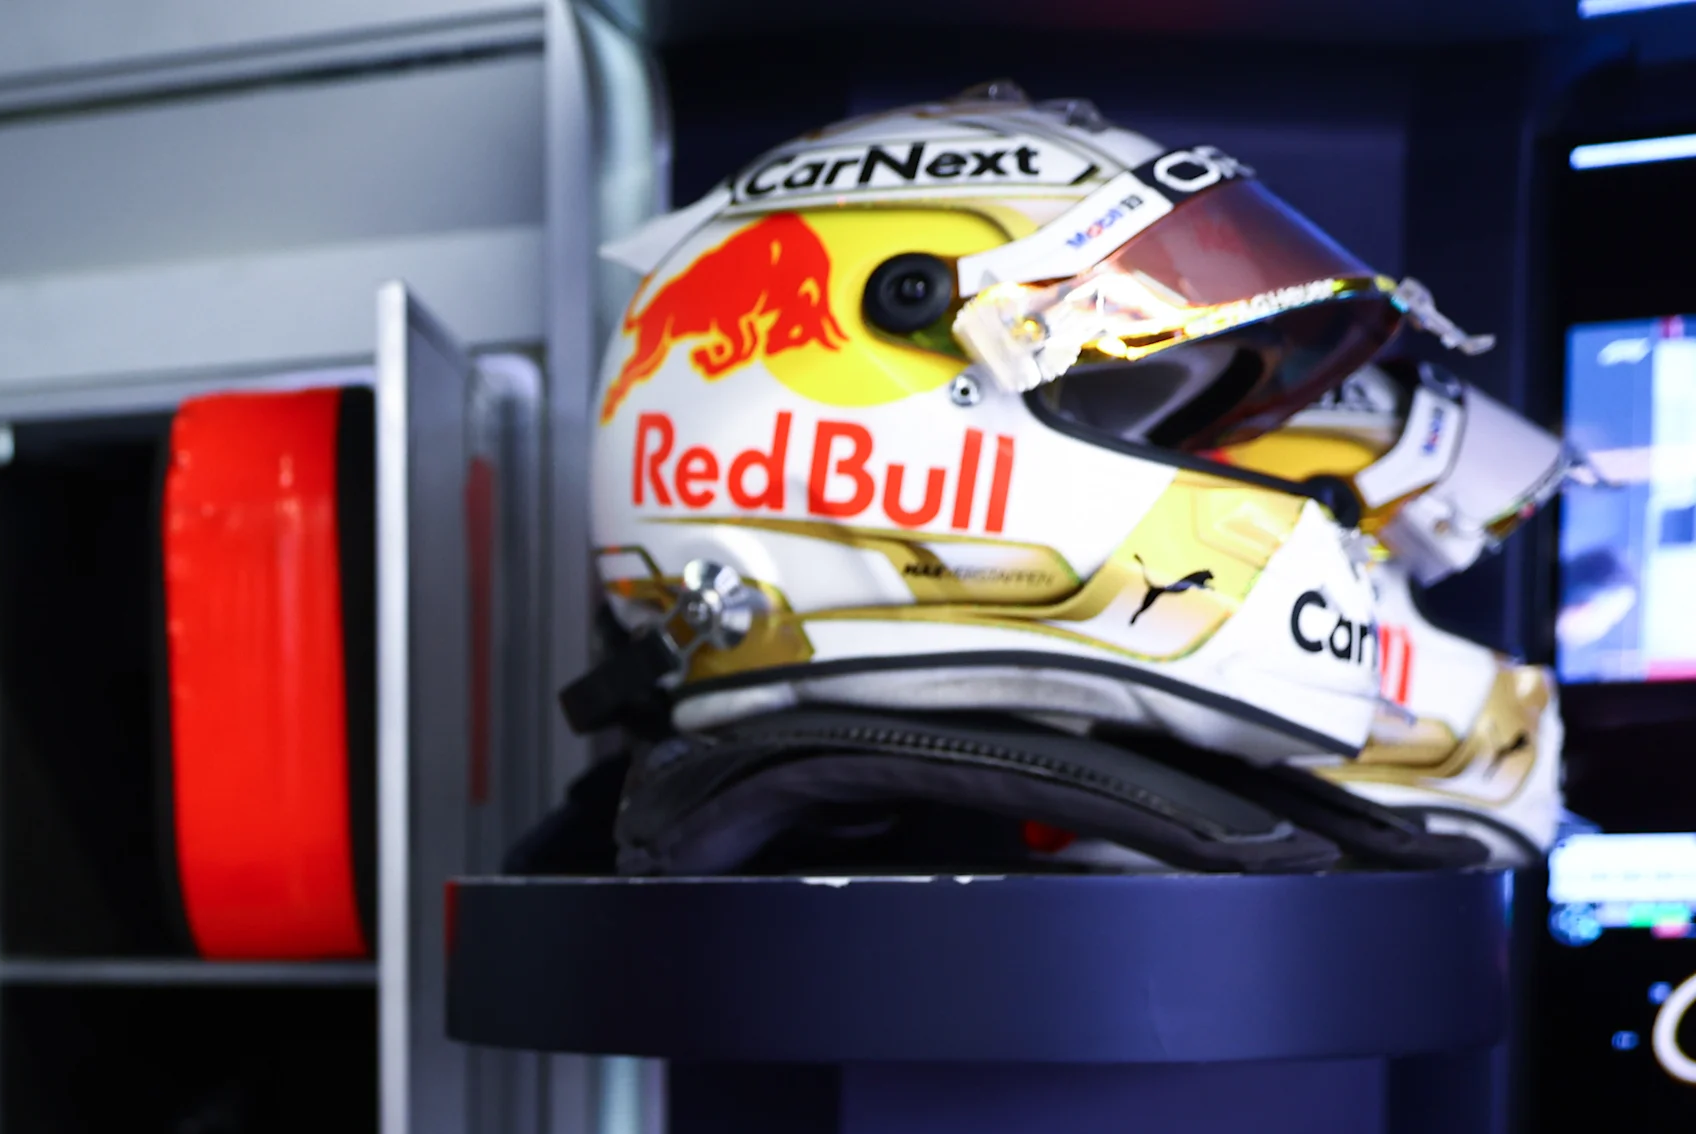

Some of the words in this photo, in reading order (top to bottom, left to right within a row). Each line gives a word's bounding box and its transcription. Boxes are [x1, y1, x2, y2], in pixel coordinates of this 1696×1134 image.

[745, 142, 1039, 196] CarNext
[631, 411, 792, 511] Red
[807, 419, 1016, 533] Bull
